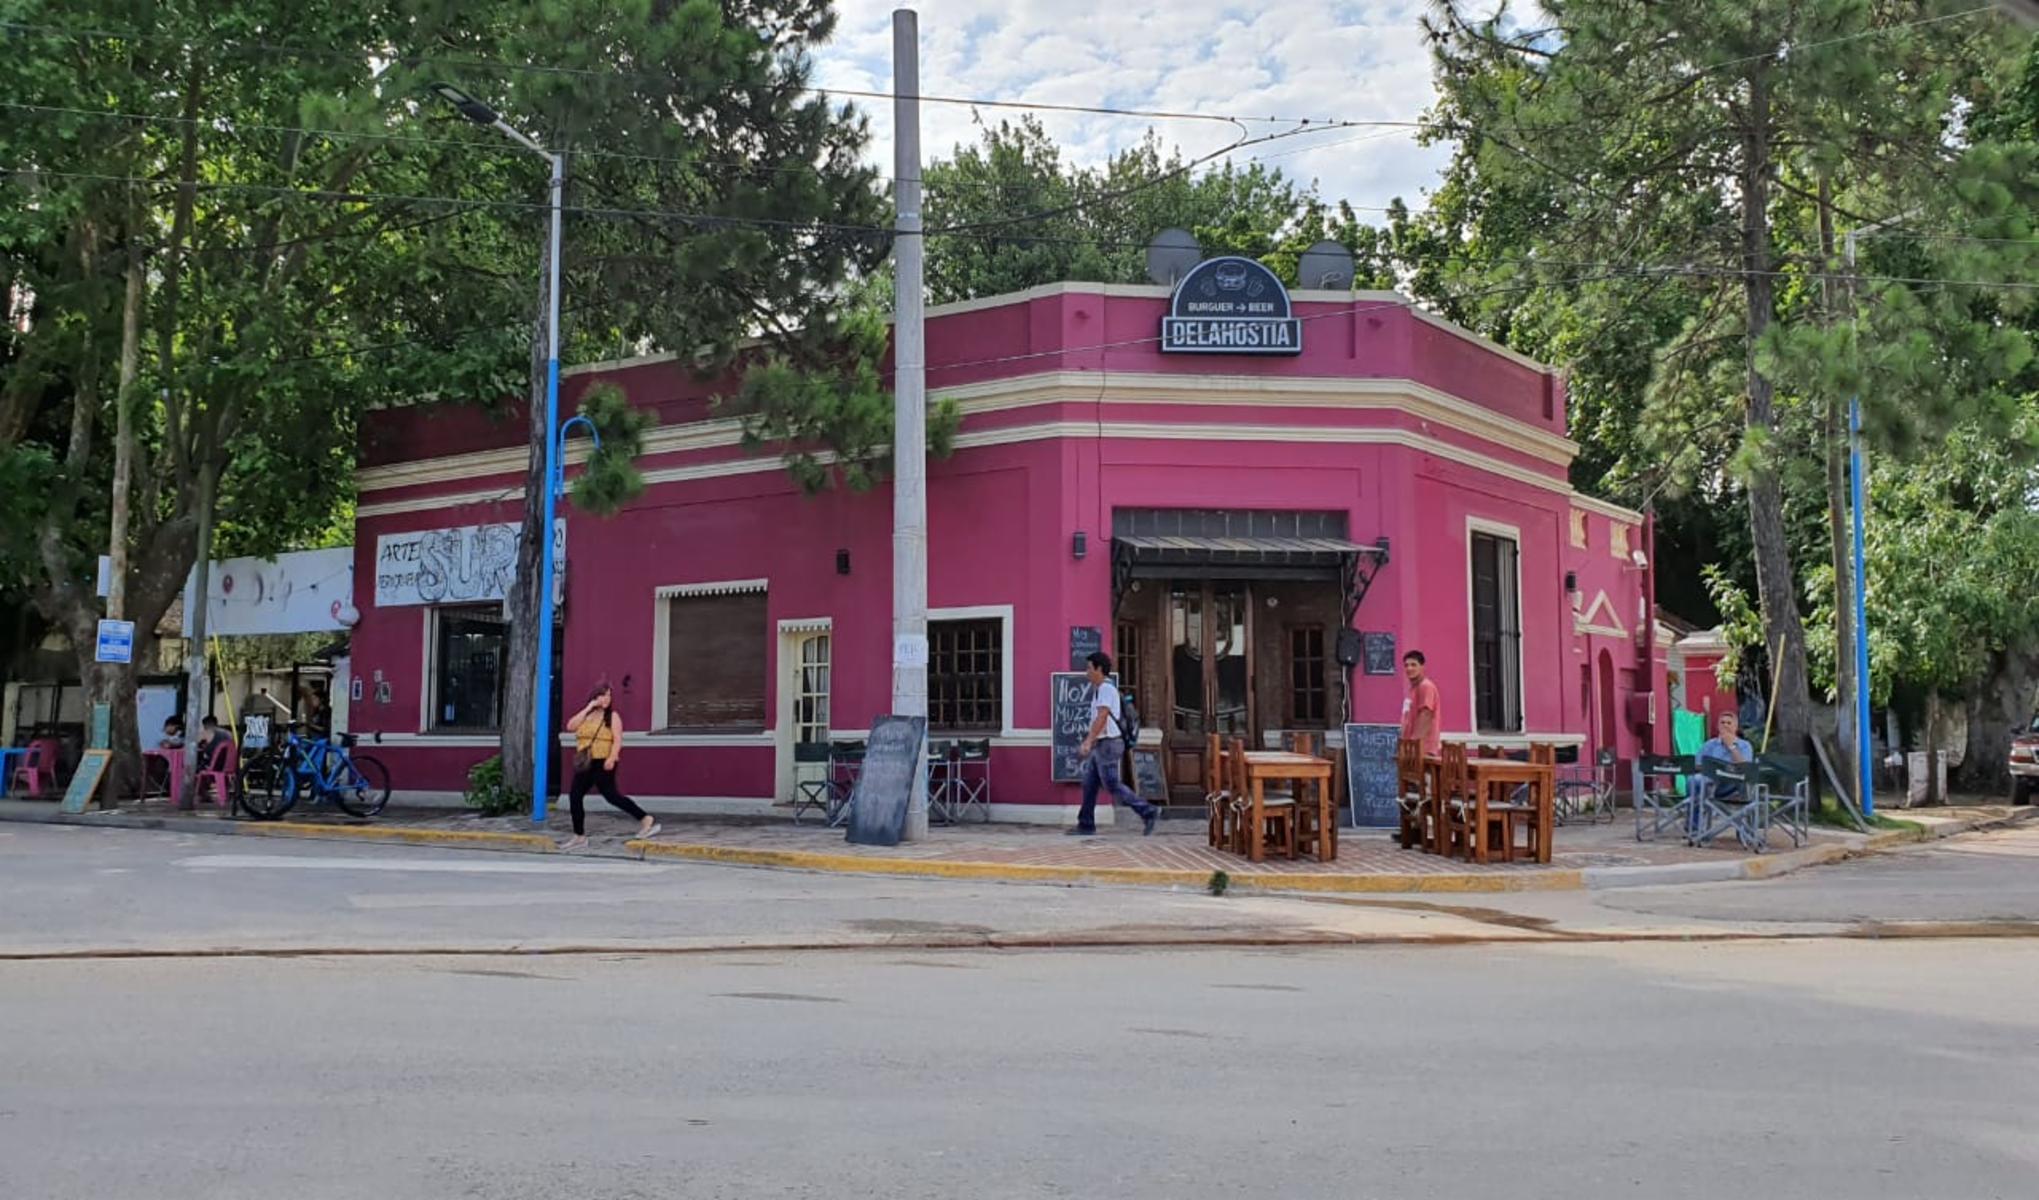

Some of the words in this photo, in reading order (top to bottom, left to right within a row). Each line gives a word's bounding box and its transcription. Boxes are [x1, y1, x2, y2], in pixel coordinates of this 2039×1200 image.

[1187, 301, 1234, 312] BURGUER
[1248, 301, 1274, 312] BEER
[1172, 321, 1291, 346] DELAHOSTIA
